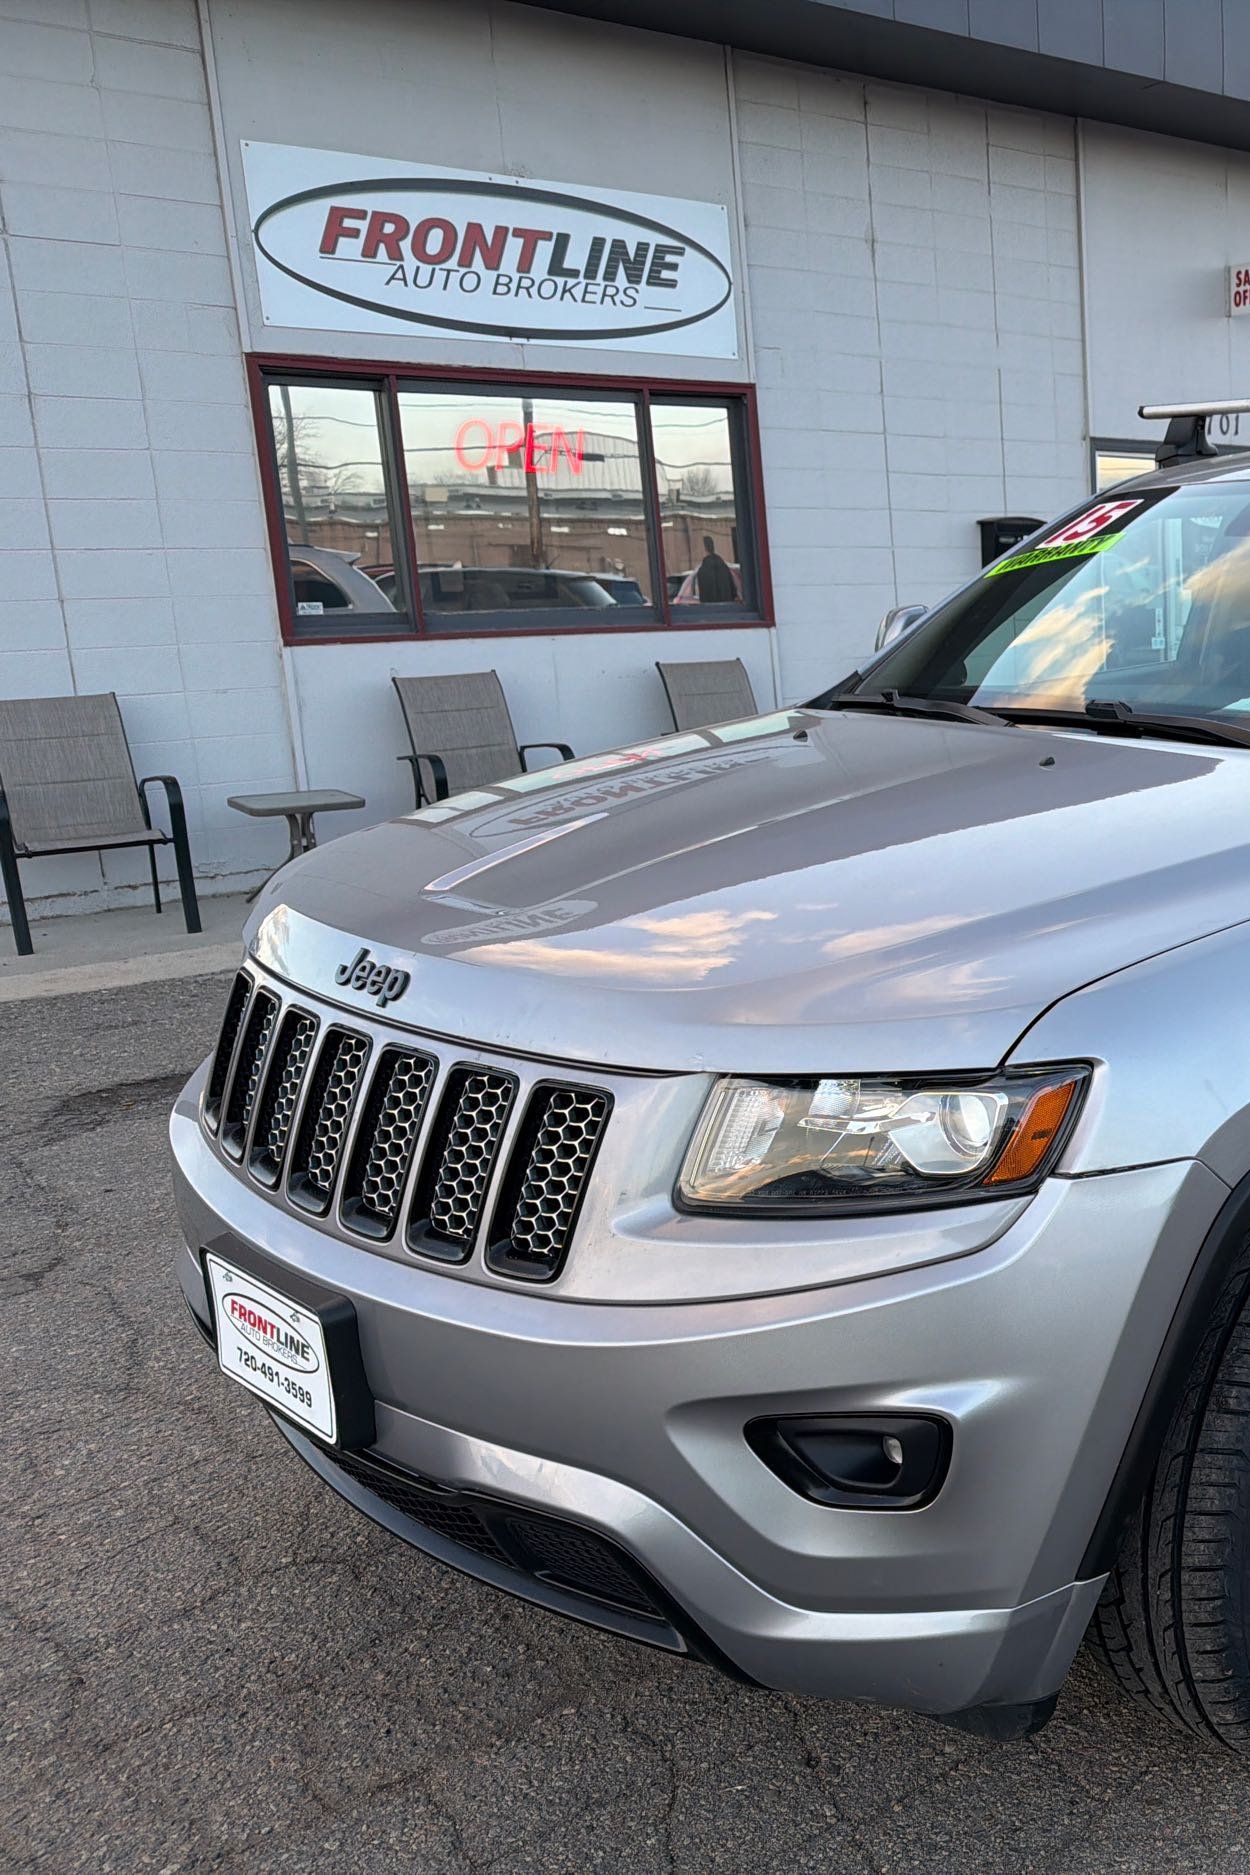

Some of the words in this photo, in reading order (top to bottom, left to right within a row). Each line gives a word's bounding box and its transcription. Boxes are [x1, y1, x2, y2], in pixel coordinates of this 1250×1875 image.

[319, 206, 685, 290] FRONTLINE
[385, 264, 481, 293] AUTO
[492, 273, 639, 308] BROKERS
[454, 418, 585, 476] OPEN
[335, 947, 411, 1008] Jeep
[231, 1299, 310, 1362] FRONTLINE
[241, 1322, 260, 1341] AUTO
[262, 1334, 298, 1365] BROKERS
[237, 1347, 313, 1408] 720-491-3599
